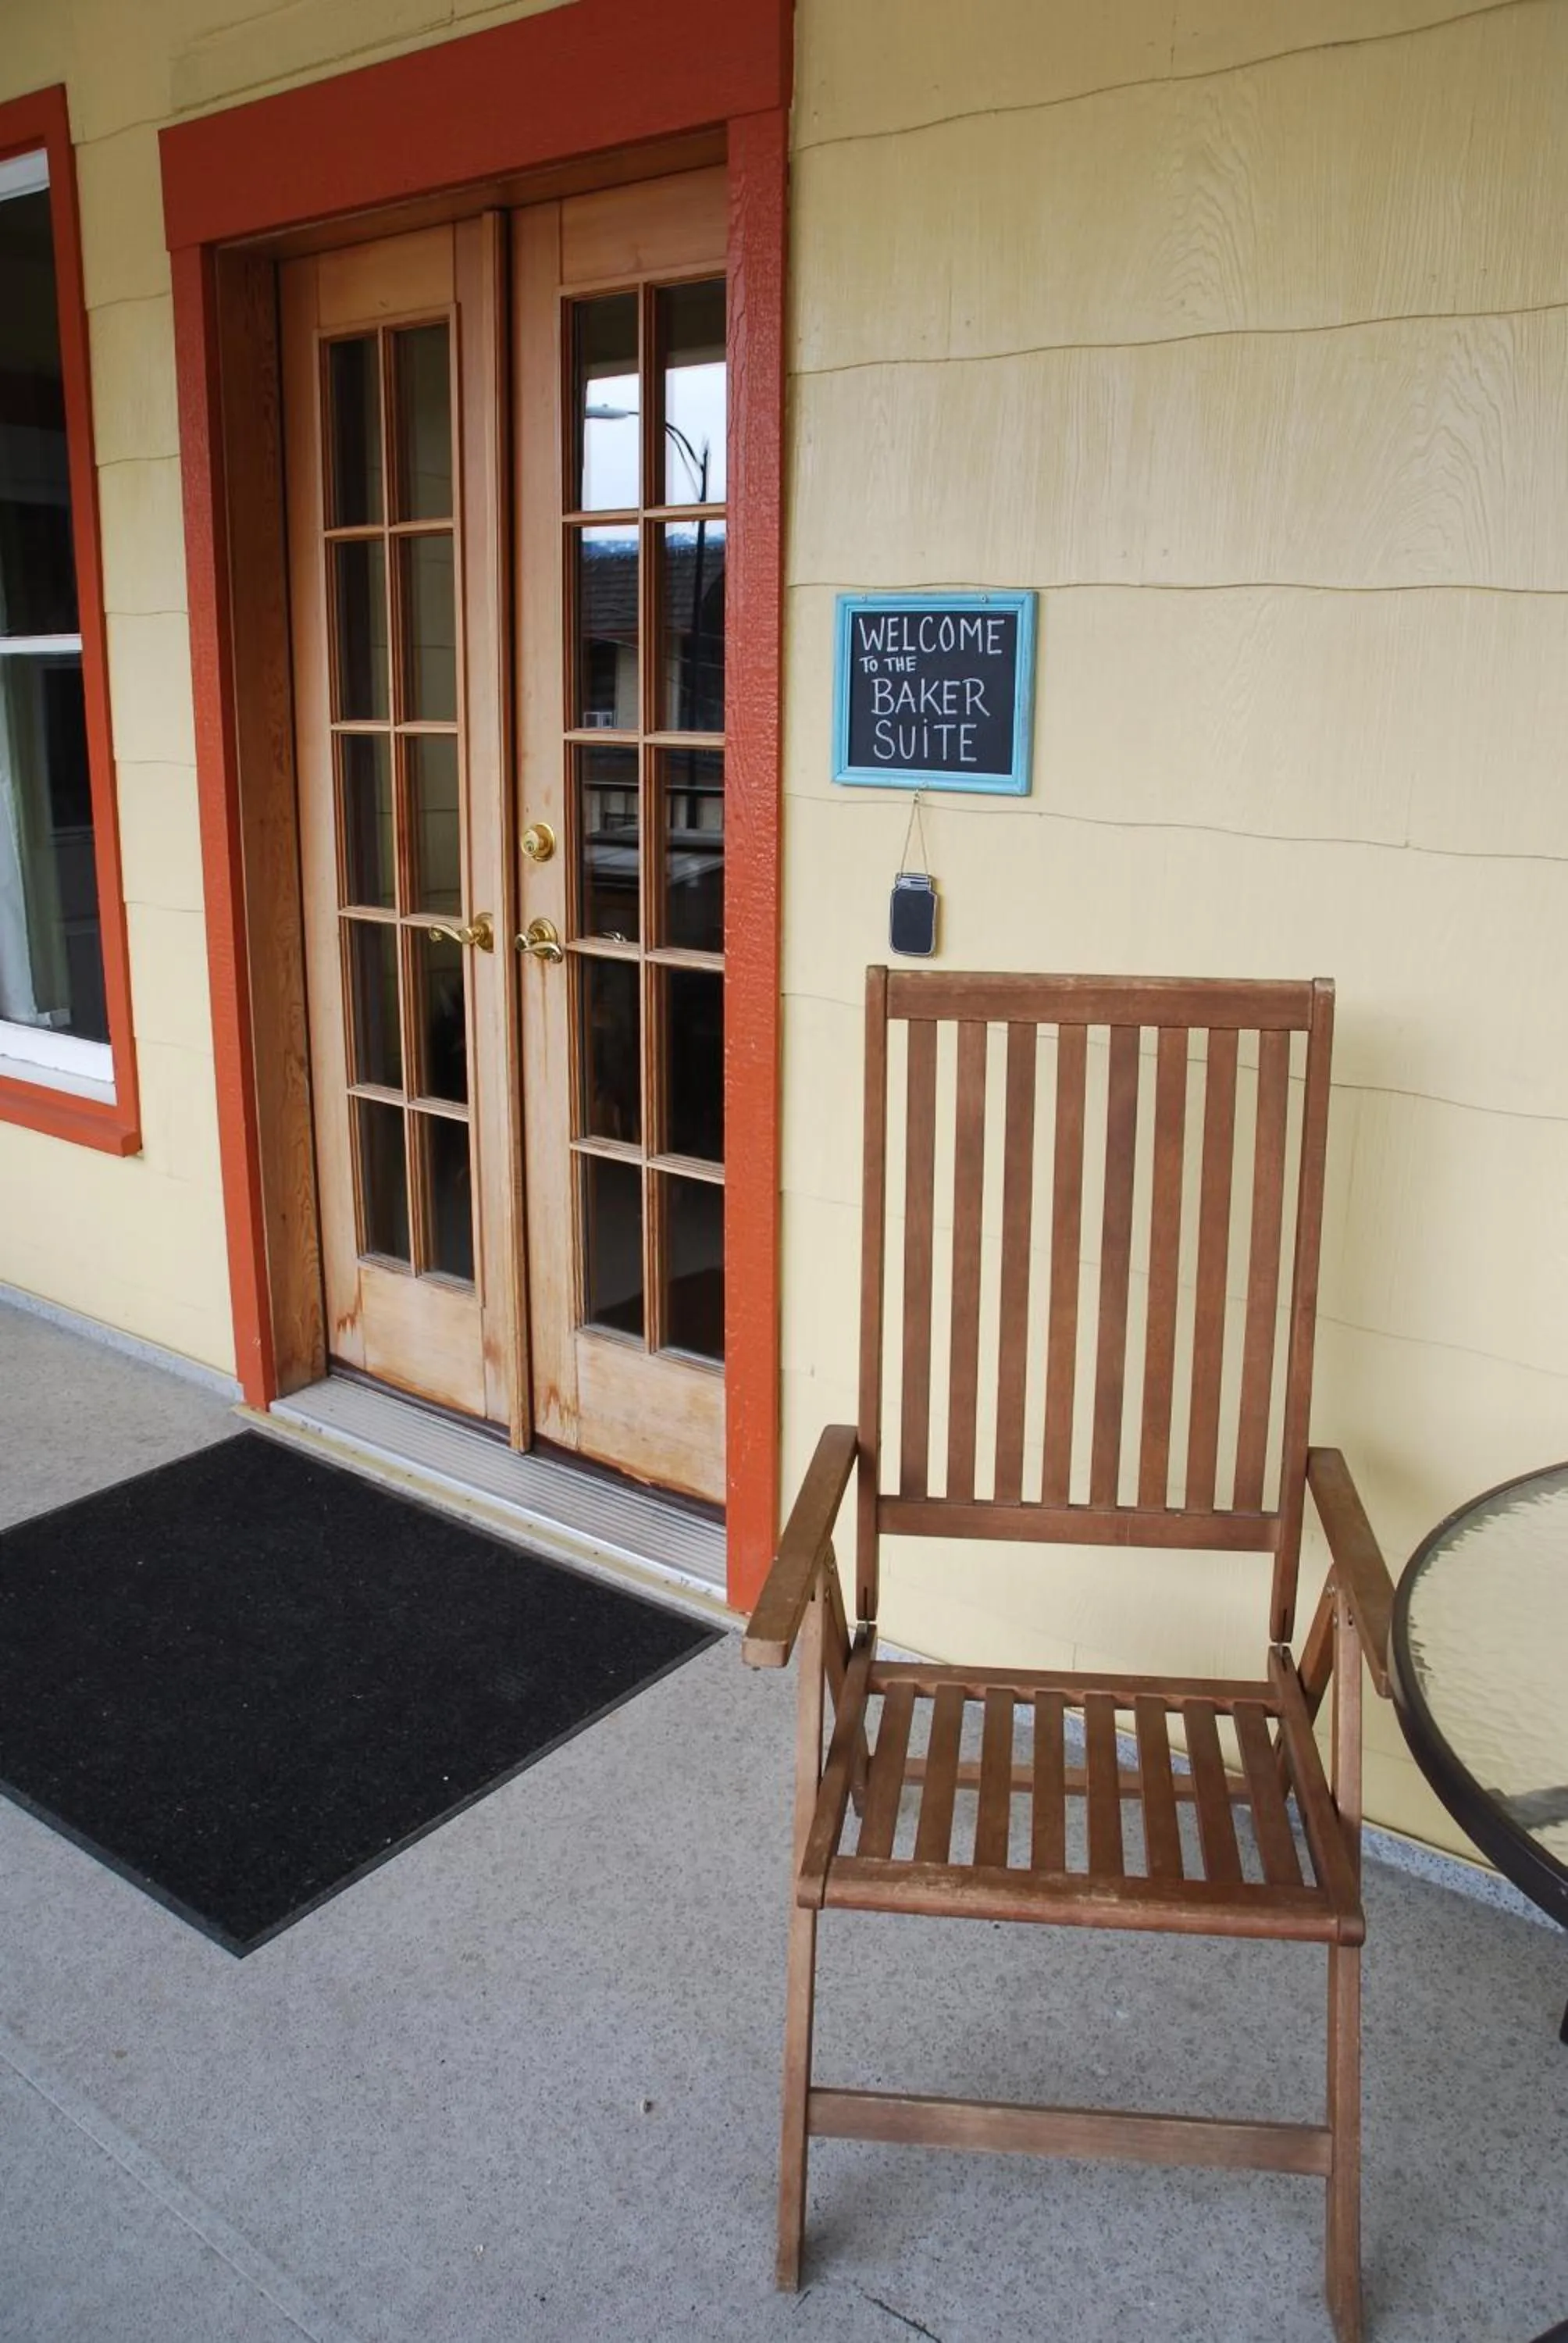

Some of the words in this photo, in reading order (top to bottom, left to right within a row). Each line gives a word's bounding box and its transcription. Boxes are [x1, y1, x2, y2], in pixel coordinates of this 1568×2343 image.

[858, 615, 1005, 654] WELCOME
[859, 655, 878, 673] TO
[883, 655, 917, 672] THE
[871, 677, 990, 717] BAKER
